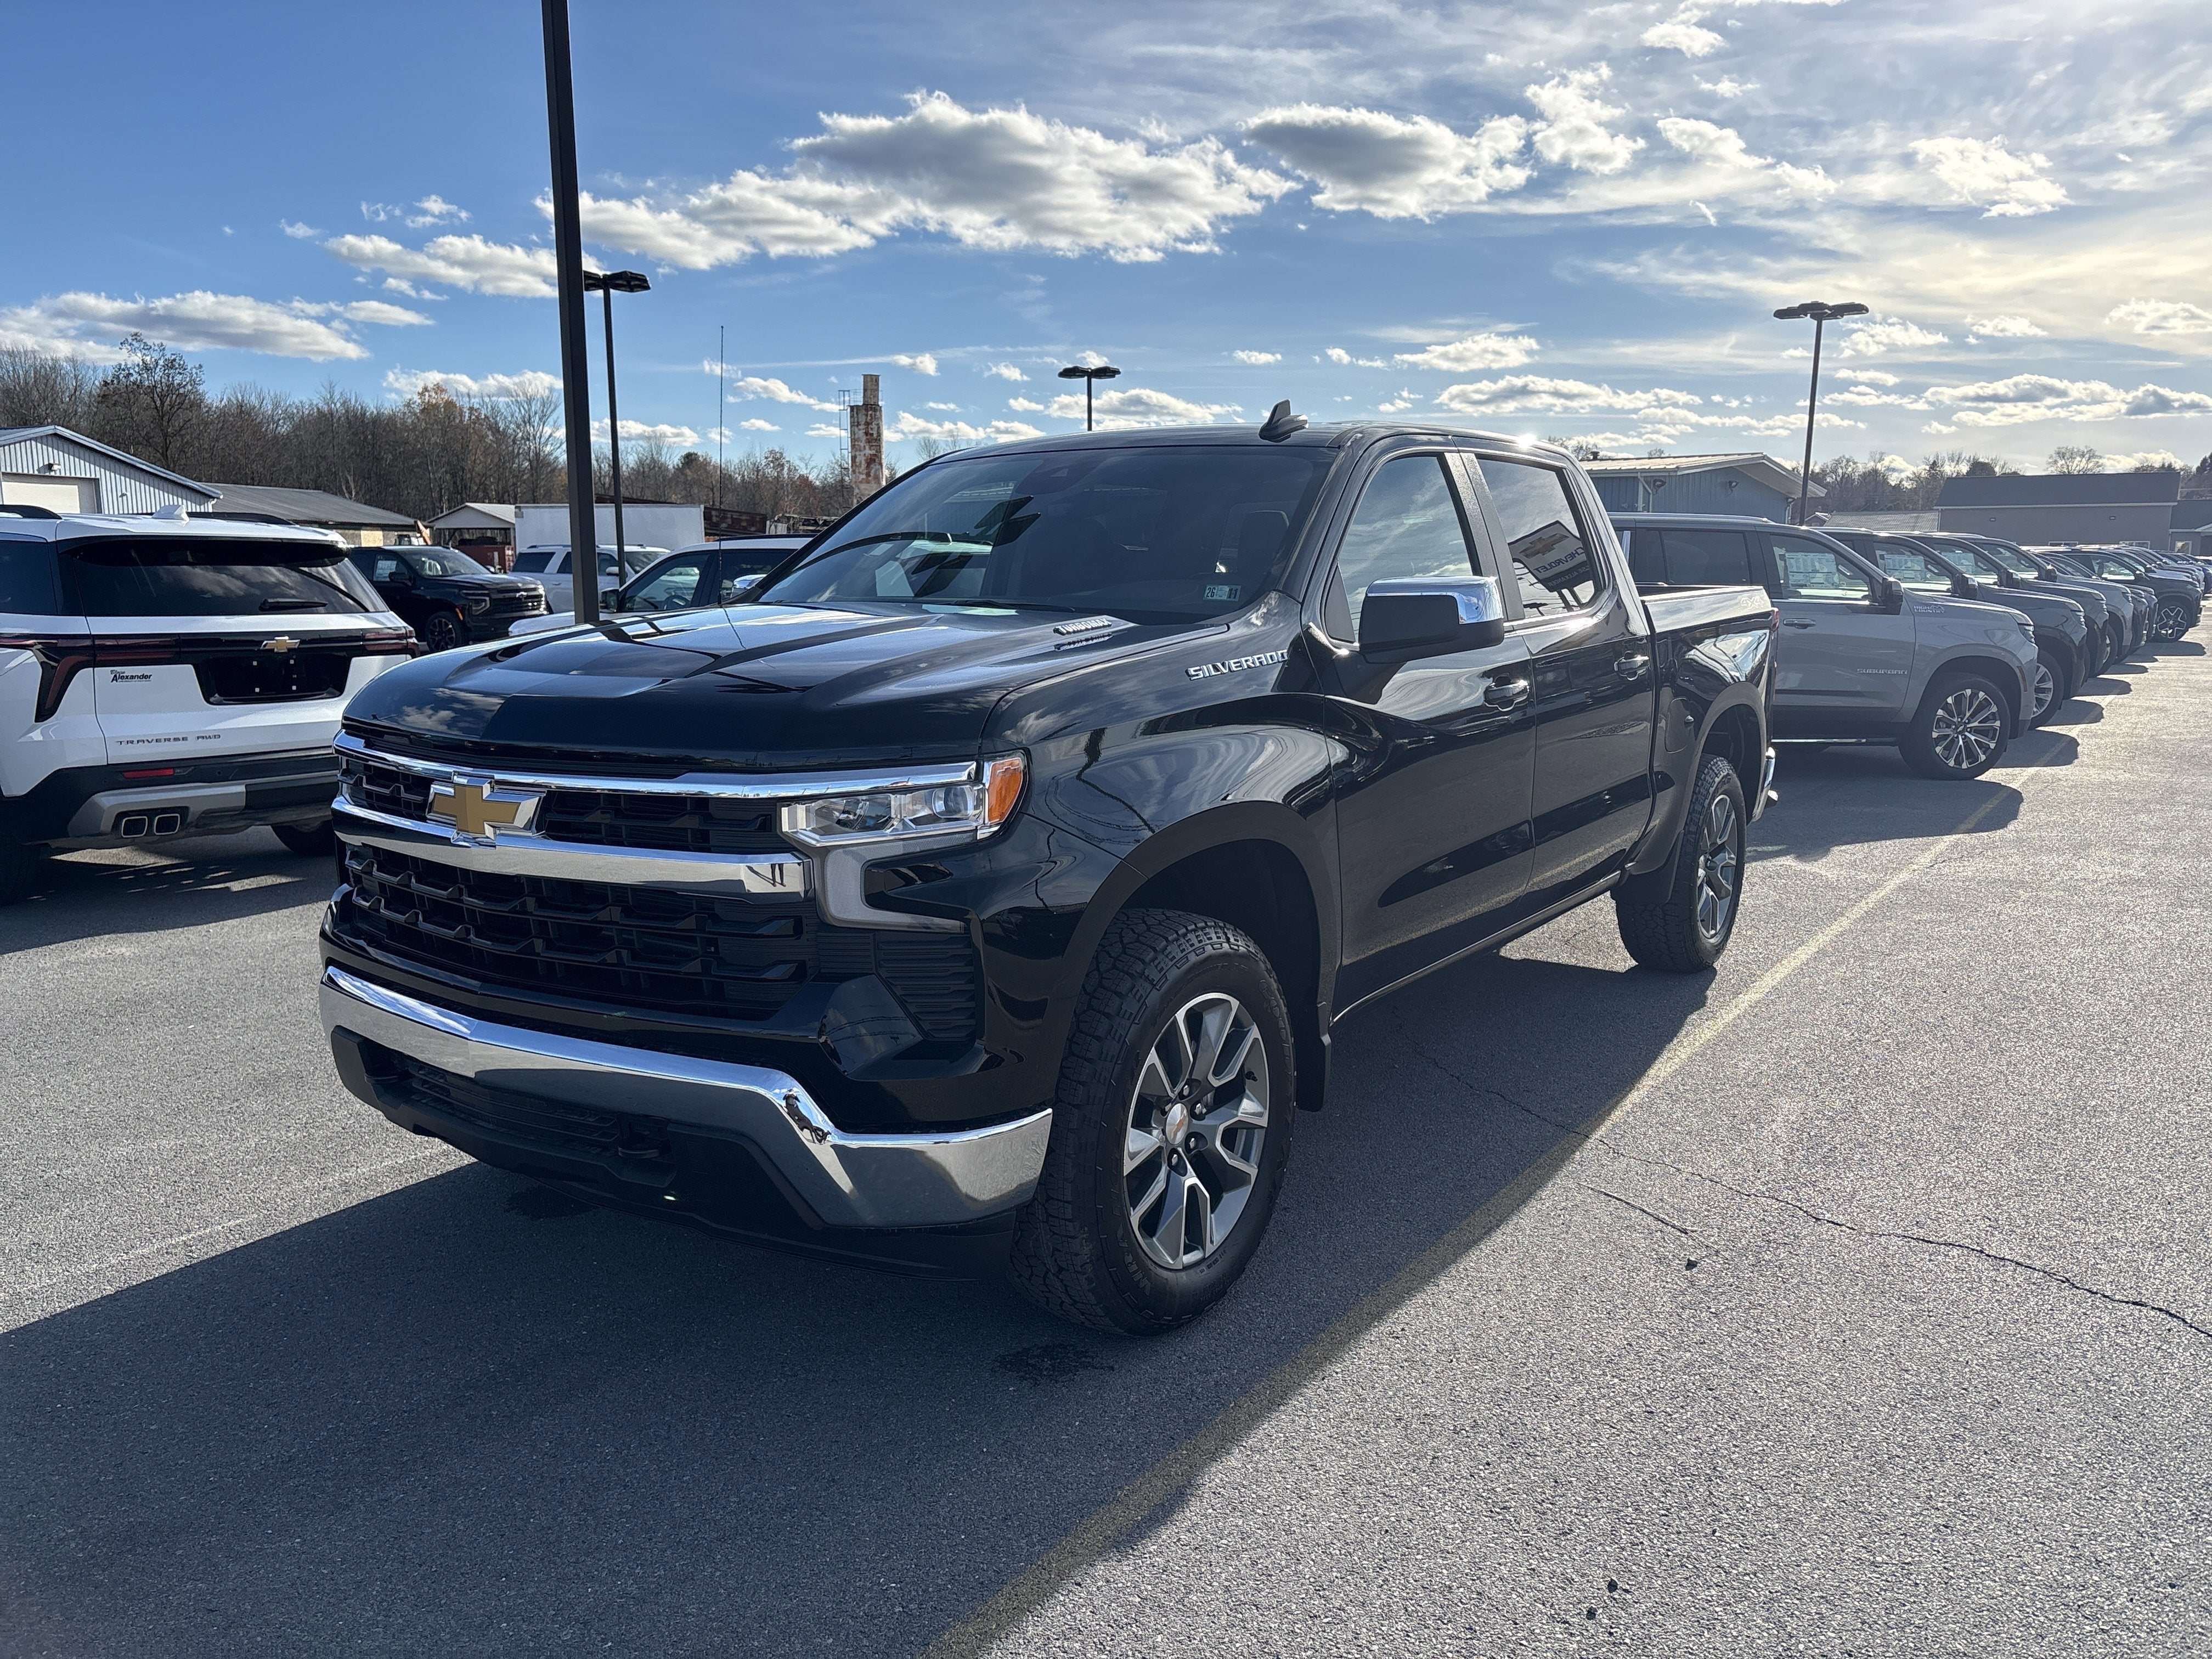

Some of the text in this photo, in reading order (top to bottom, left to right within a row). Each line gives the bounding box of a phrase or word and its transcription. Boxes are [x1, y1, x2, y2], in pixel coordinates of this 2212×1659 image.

[1206, 586, 1216, 598] 26
[1054, 618, 1112, 635] TURBOMAX
[1186, 650, 1288, 680] SILVERADO
[111, 673, 153, 683] Alexander
[117, 736, 189, 746] TRAVERSE
